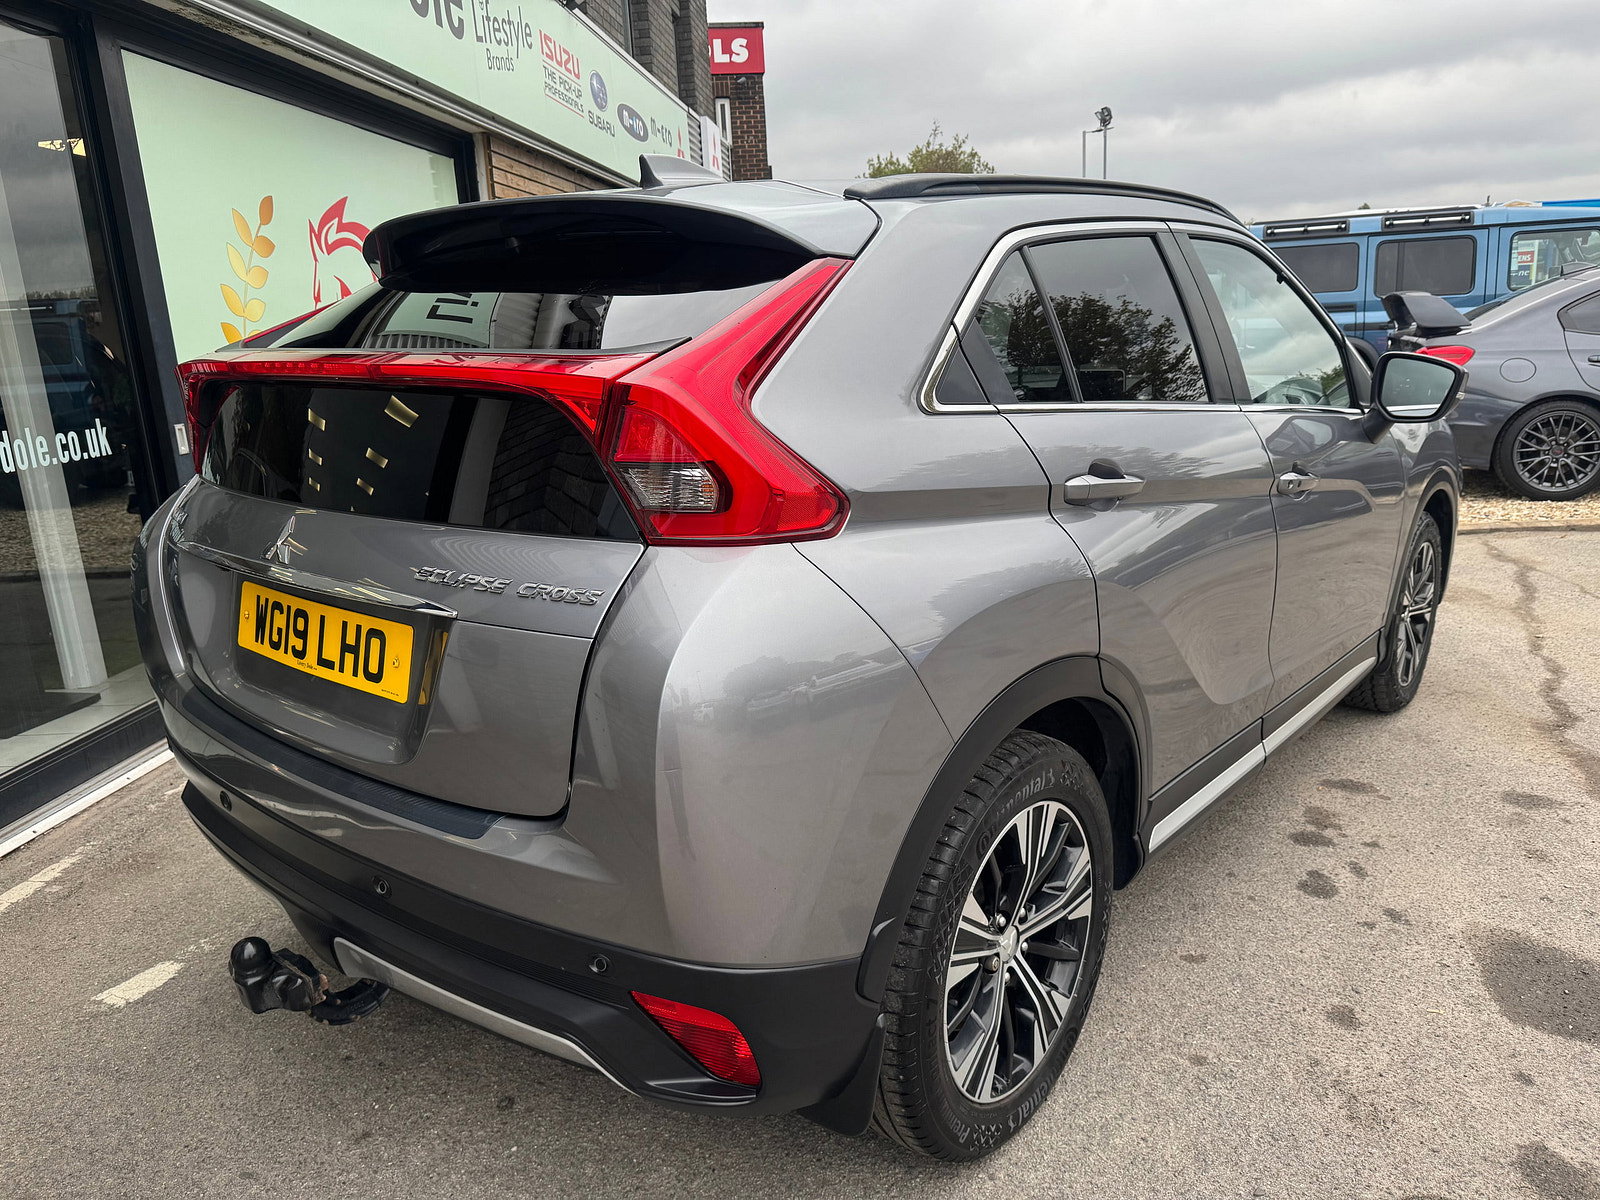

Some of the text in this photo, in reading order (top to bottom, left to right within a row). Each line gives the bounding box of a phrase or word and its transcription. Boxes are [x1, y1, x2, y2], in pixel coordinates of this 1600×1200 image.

[472, 0, 533, 59] Lifestyle
[486, 48, 515, 72] Brands
[539, 29, 581, 80] ISUZU
[708, 37, 749, 64] LS
[543, 65, 583, 100] THE PICK-UP
[544, 81, 585, 113] PROFESSIONALS
[588, 110, 616, 138] SUBARU
[0, 418, 113, 474] dole.co.uk
[413, 566, 606, 606] ECLIPSE CROSS
[254, 594, 387, 684] WG19 LHO
